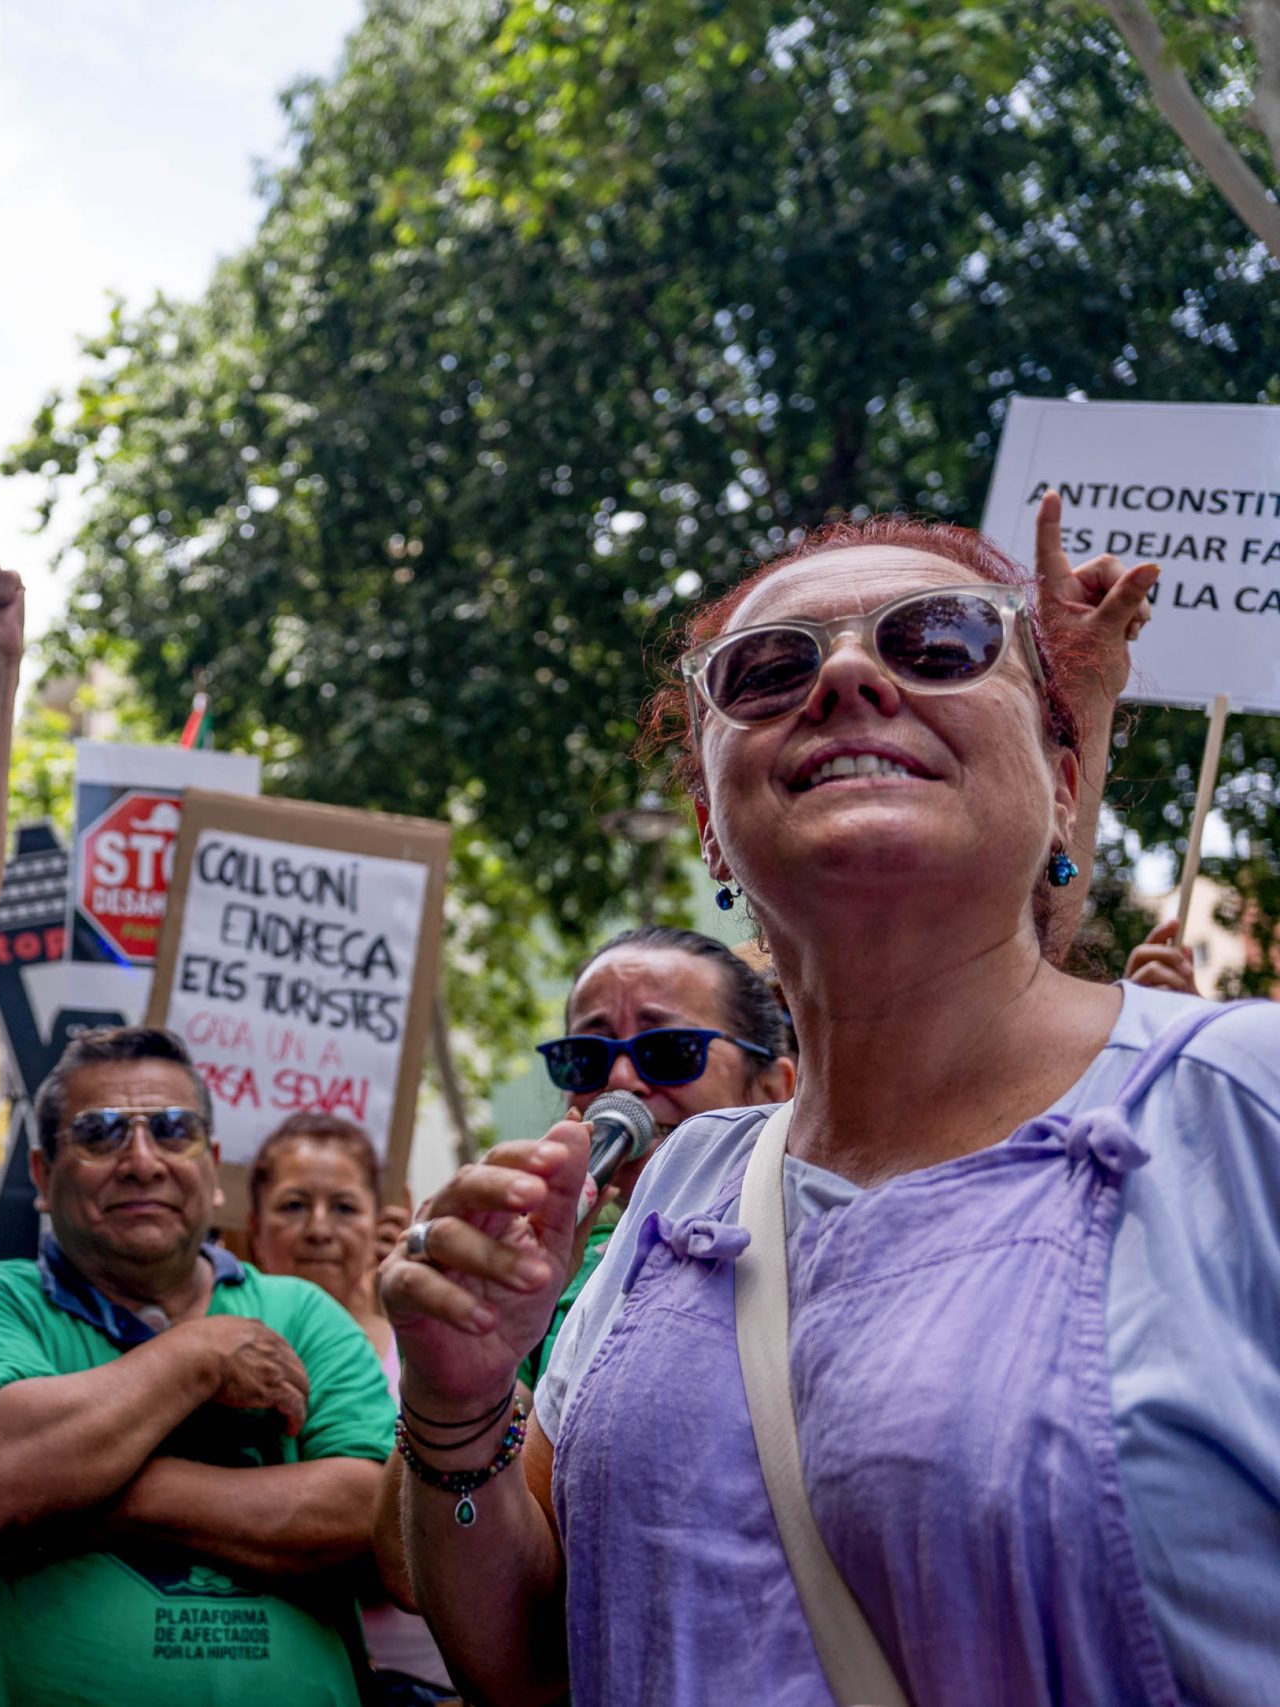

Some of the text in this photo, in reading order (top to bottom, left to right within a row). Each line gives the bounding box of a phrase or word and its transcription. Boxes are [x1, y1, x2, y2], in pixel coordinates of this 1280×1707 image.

[1106, 530, 1227, 564] DEJAR
[1173, 582, 1220, 612] LA
[1234, 585, 1280, 616] CA
[220, 902, 399, 981] ENDREÇA
[180, 953, 247, 1002] ELS
[319, 1039, 345, 1068] A
[155, 1608, 269, 1626] PLATAFORMA
[154, 1627, 270, 1644] DE AFECTADOS
[152, 1645, 270, 1661] POR LA HIPOTECA
